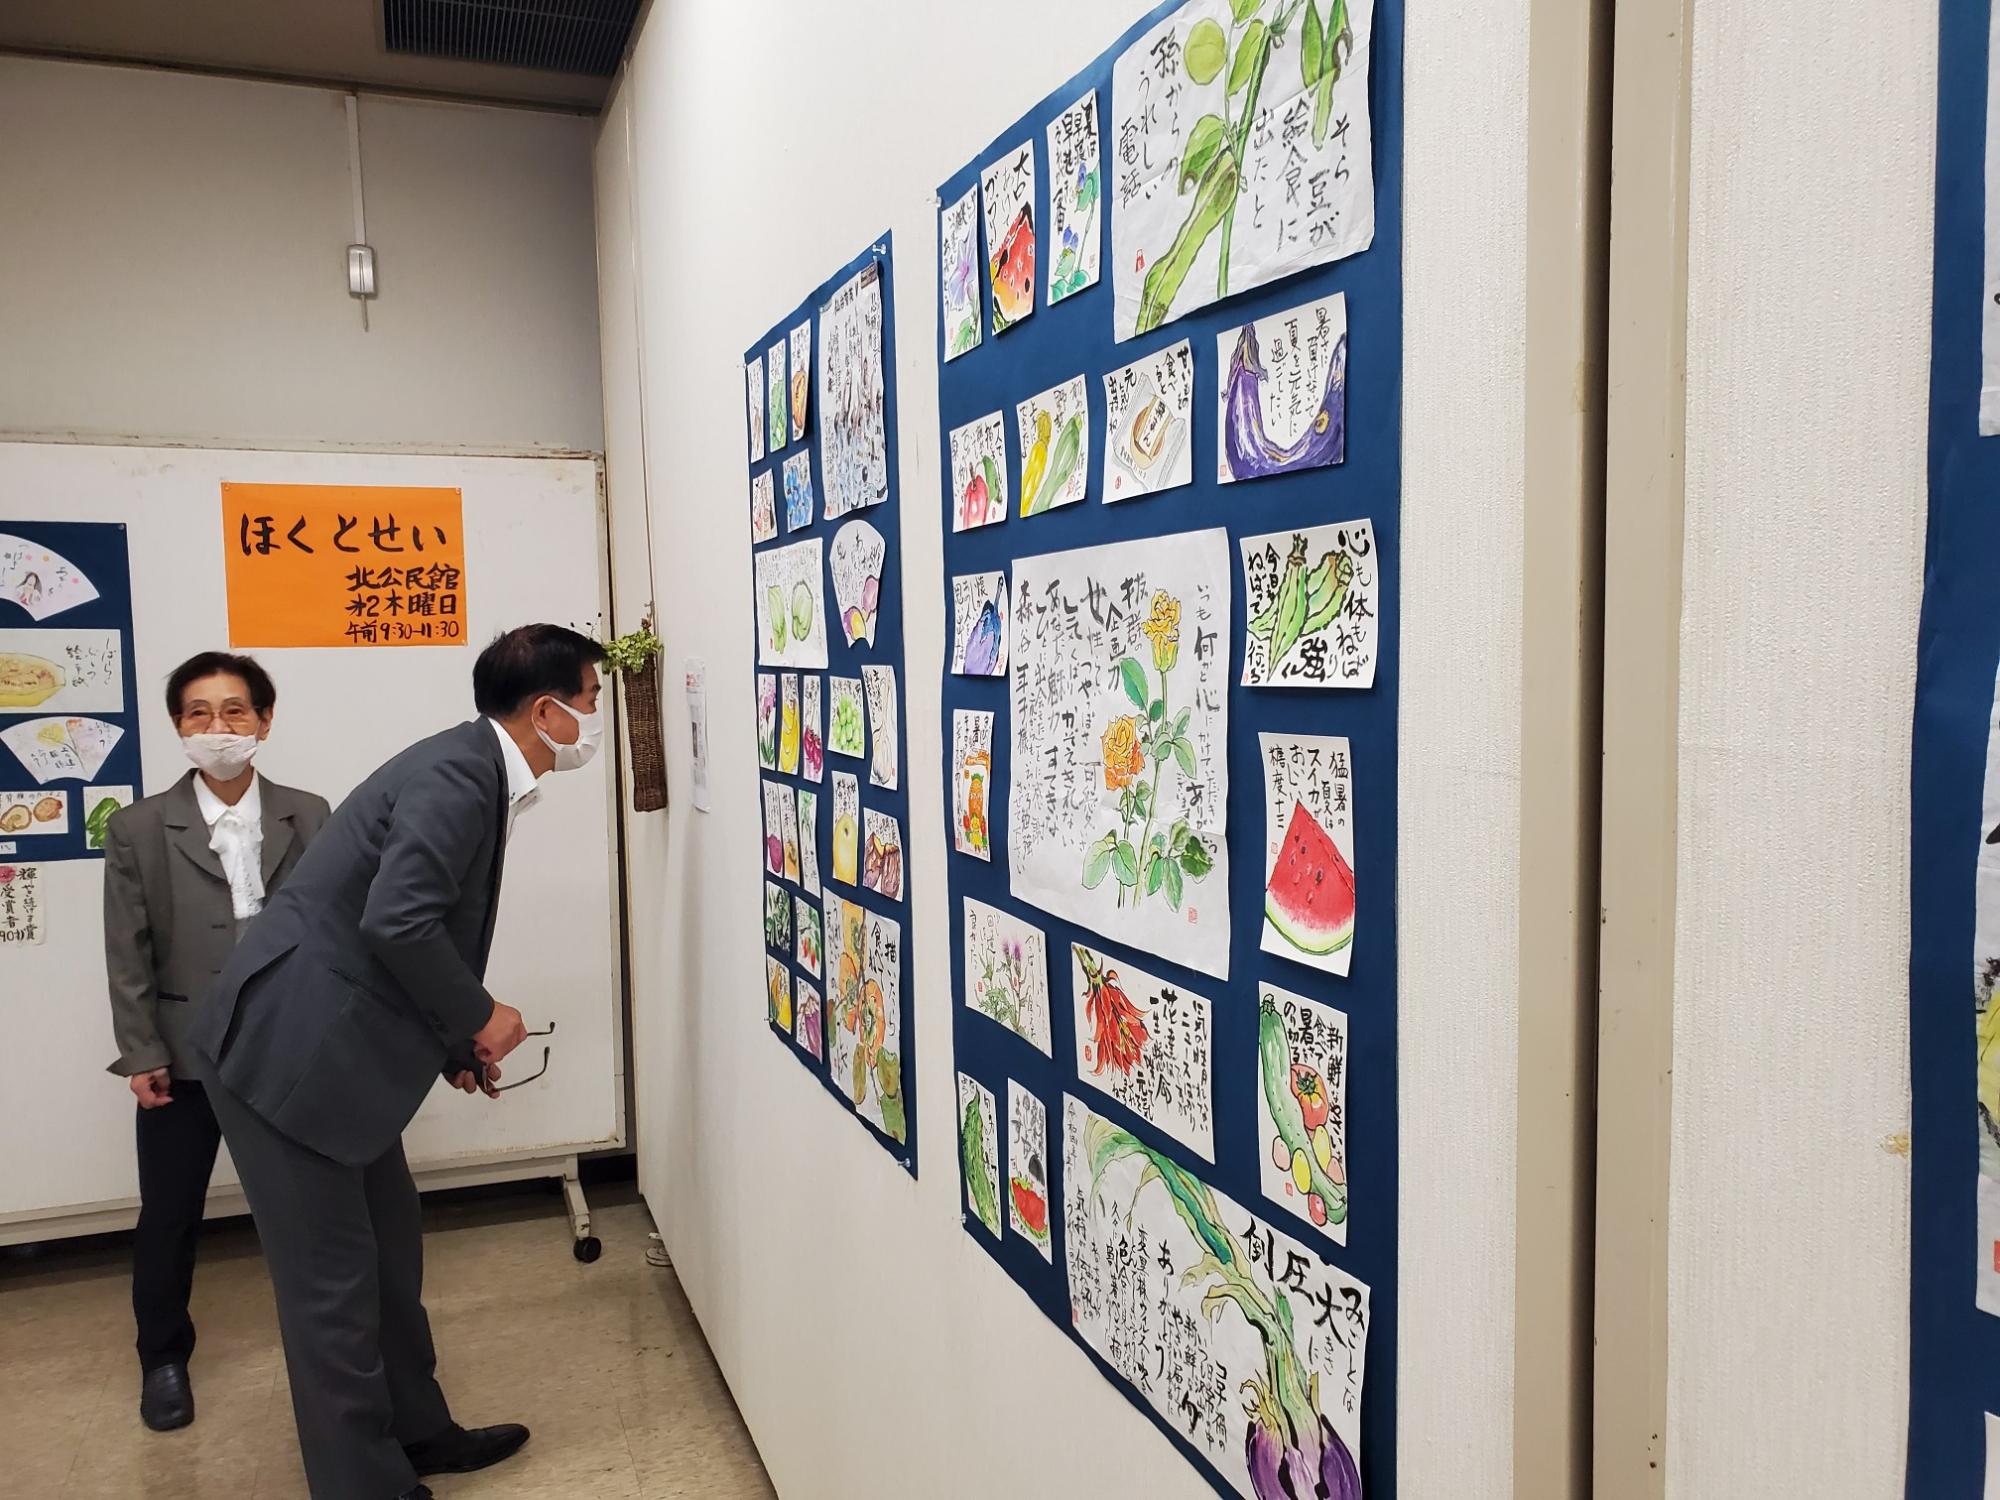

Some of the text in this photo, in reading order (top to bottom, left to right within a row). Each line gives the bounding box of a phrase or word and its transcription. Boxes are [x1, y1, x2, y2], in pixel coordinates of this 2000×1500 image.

[241, 513, 446, 556] ほくとせい
[346, 562, 461, 592] 北公民館
[1283, 1000, 1301, 1064] のり切る
